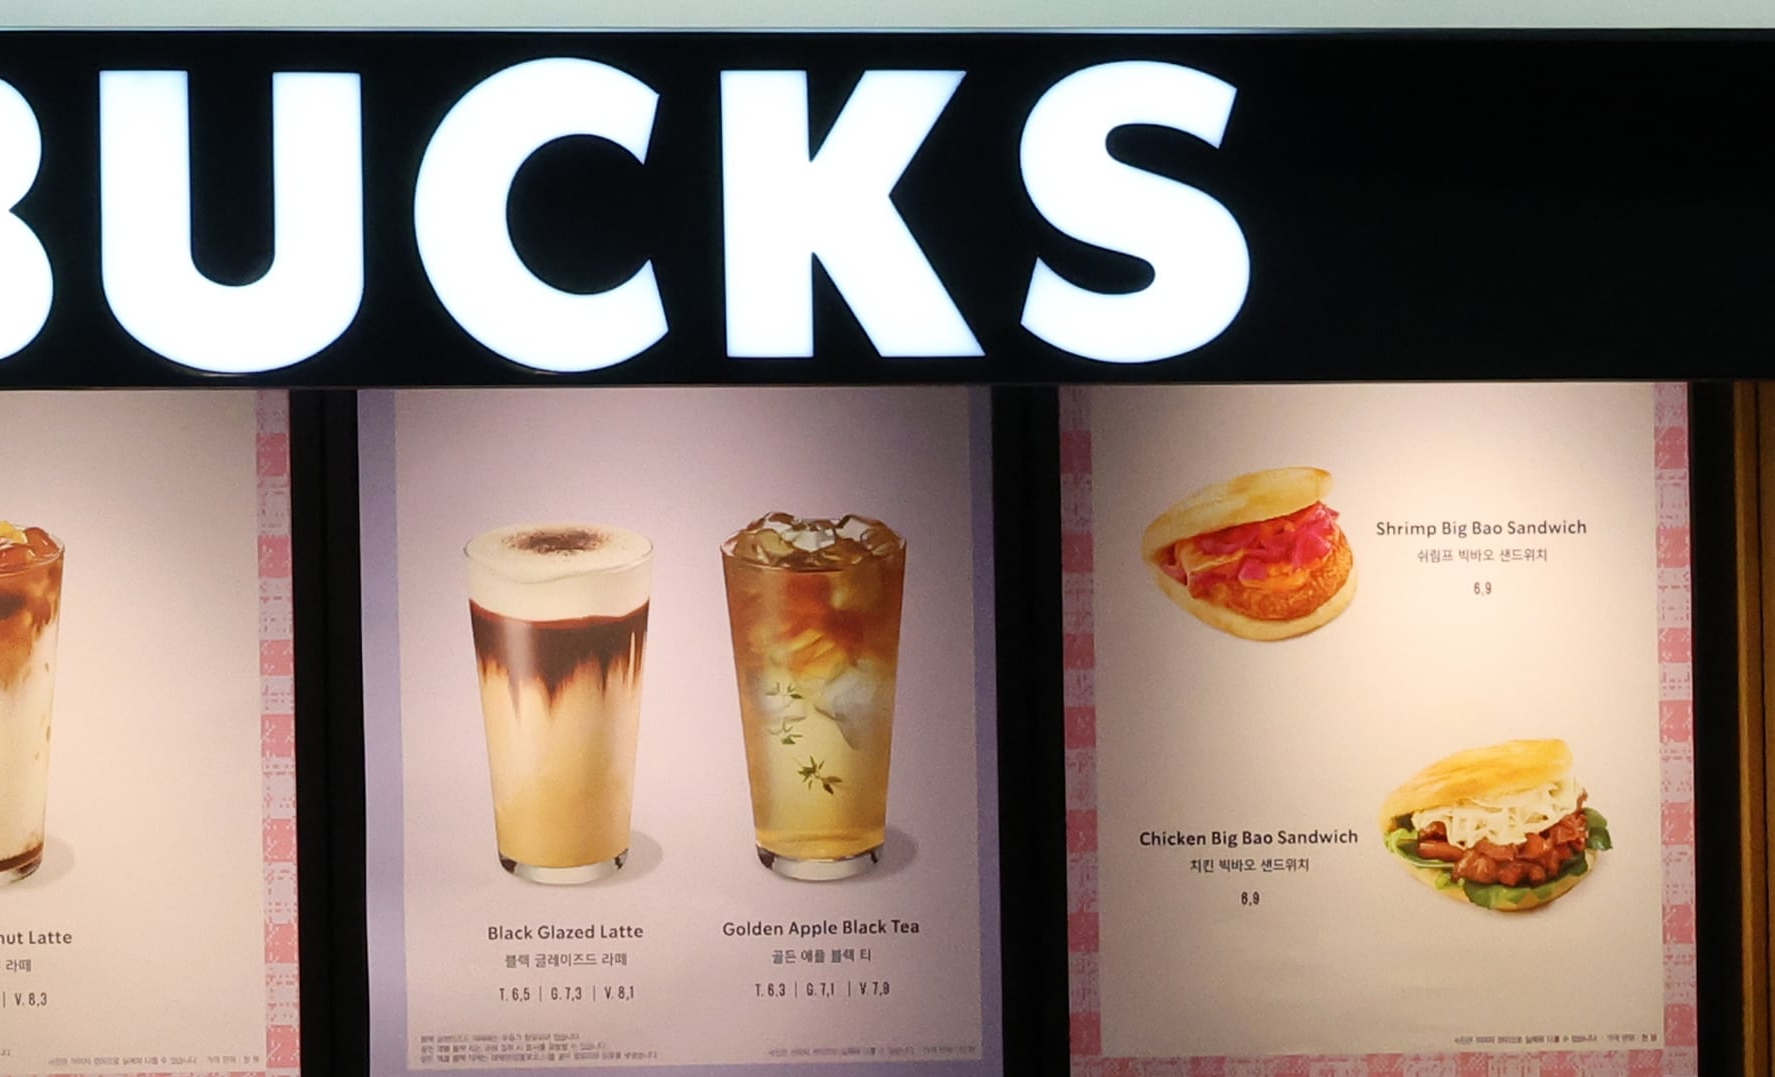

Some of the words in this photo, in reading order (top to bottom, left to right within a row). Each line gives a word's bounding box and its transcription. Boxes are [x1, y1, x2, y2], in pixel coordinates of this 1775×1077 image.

[1376, 521, 1437, 538] Shrimp
[1442, 520, 1467, 538] Big
[1472, 521, 1503, 535] Bao
[1507, 520, 1587, 535] Sandwich
[1417, 549, 1454, 563] 쉬림프
[1458, 548, 1495, 563] 빅바오
[1500, 548, 1548, 562] 샌드위치
[1139, 831, 1207, 846] Chicken
[1211, 831, 1238, 848] Big
[1242, 831, 1273, 845] Bao
[1277, 829, 1358, 845] Sandwich
[1190, 859, 1214, 873] 치킨
[1219, 858, 1256, 873] 빅바오
[1261, 858, 1309, 872] 샌드위치
[488, 925, 533, 940] Black
[538, 925, 595, 940] Glazed
[601, 924, 644, 939] Latte
[722, 921, 783, 937] Golden
[788, 920, 838, 938] Apple
[842, 919, 887, 935] Black
[891, 919, 920, 934] Tea
[28, 930, 73, 944] Latte
[534, 953, 597, 968] 글레이즈드
[601, 953, 627, 966] 라떼
[860, 948, 871, 962] 티
[6, 958, 32, 973] 라떼
